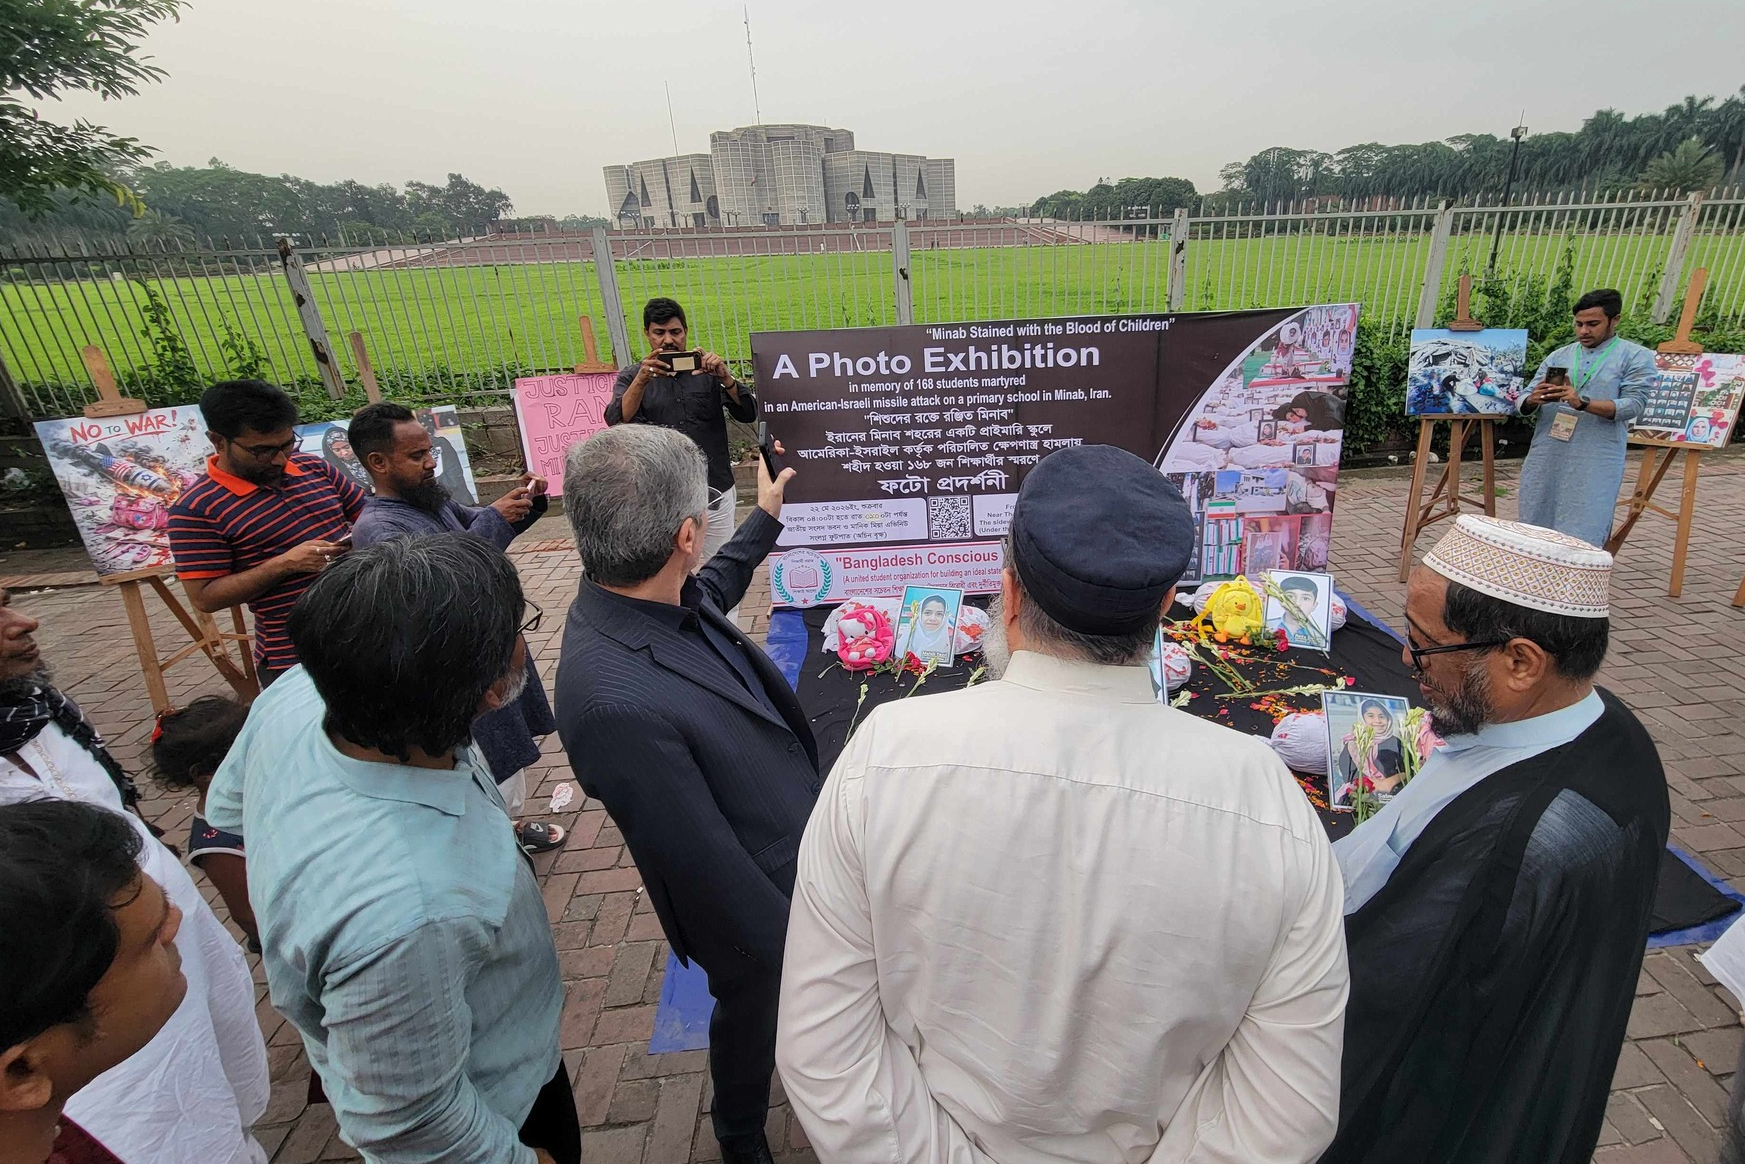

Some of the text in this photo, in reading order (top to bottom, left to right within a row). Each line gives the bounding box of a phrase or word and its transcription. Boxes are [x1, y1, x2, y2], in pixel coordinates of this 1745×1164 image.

[926, 318, 1176, 340] “Minab Stained with the Blood of Children”
[772, 342, 1100, 379] A Photo Exhibition
[849, 374, 1026, 394] in memory of 168 students martyred
[764, 388, 1112, 413] in an American-Israeli missile attack on a primary school in Minab, Iran.
[864, 406, 1014, 426] "শিশুদের রক্তে রঞ্জিত মিনাব"
[70, 410, 178, 444] NO TO WAR!
[825, 422, 1054, 444] ইরানের মিনাব শহরের একটি প্রাইমারি স্কুলে
[796, 444, 900, 460] আমেরিকা-ইসরাইল
[902, 442, 934, 458] কর্তৃক
[936, 440, 990, 454] পরিচালিত
[992, 439, 1040, 452] ক্ষেপণাস্ত্র
[841, 459, 872, 474] শহীদ
[874, 459, 904, 472] হওয়া
[907, 460, 932, 470] ১৬৮
[934, 458, 954, 469] জন
[956, 453, 1005, 468] শিক্ষার্থীর
[878, 469, 1010, 494] ফটো প্রদর্শনী
[836, 550, 998, 571] "Bangladesh Conscious
[843, 575, 850, 585] (A
[851, 574, 869, 583] united
[870, 573, 892, 581] student
[893, 570, 929, 581] organization
[930, 570, 939, 578] for
[940, 568, 963, 578] building
[972, 568, 986, 576] ideal
